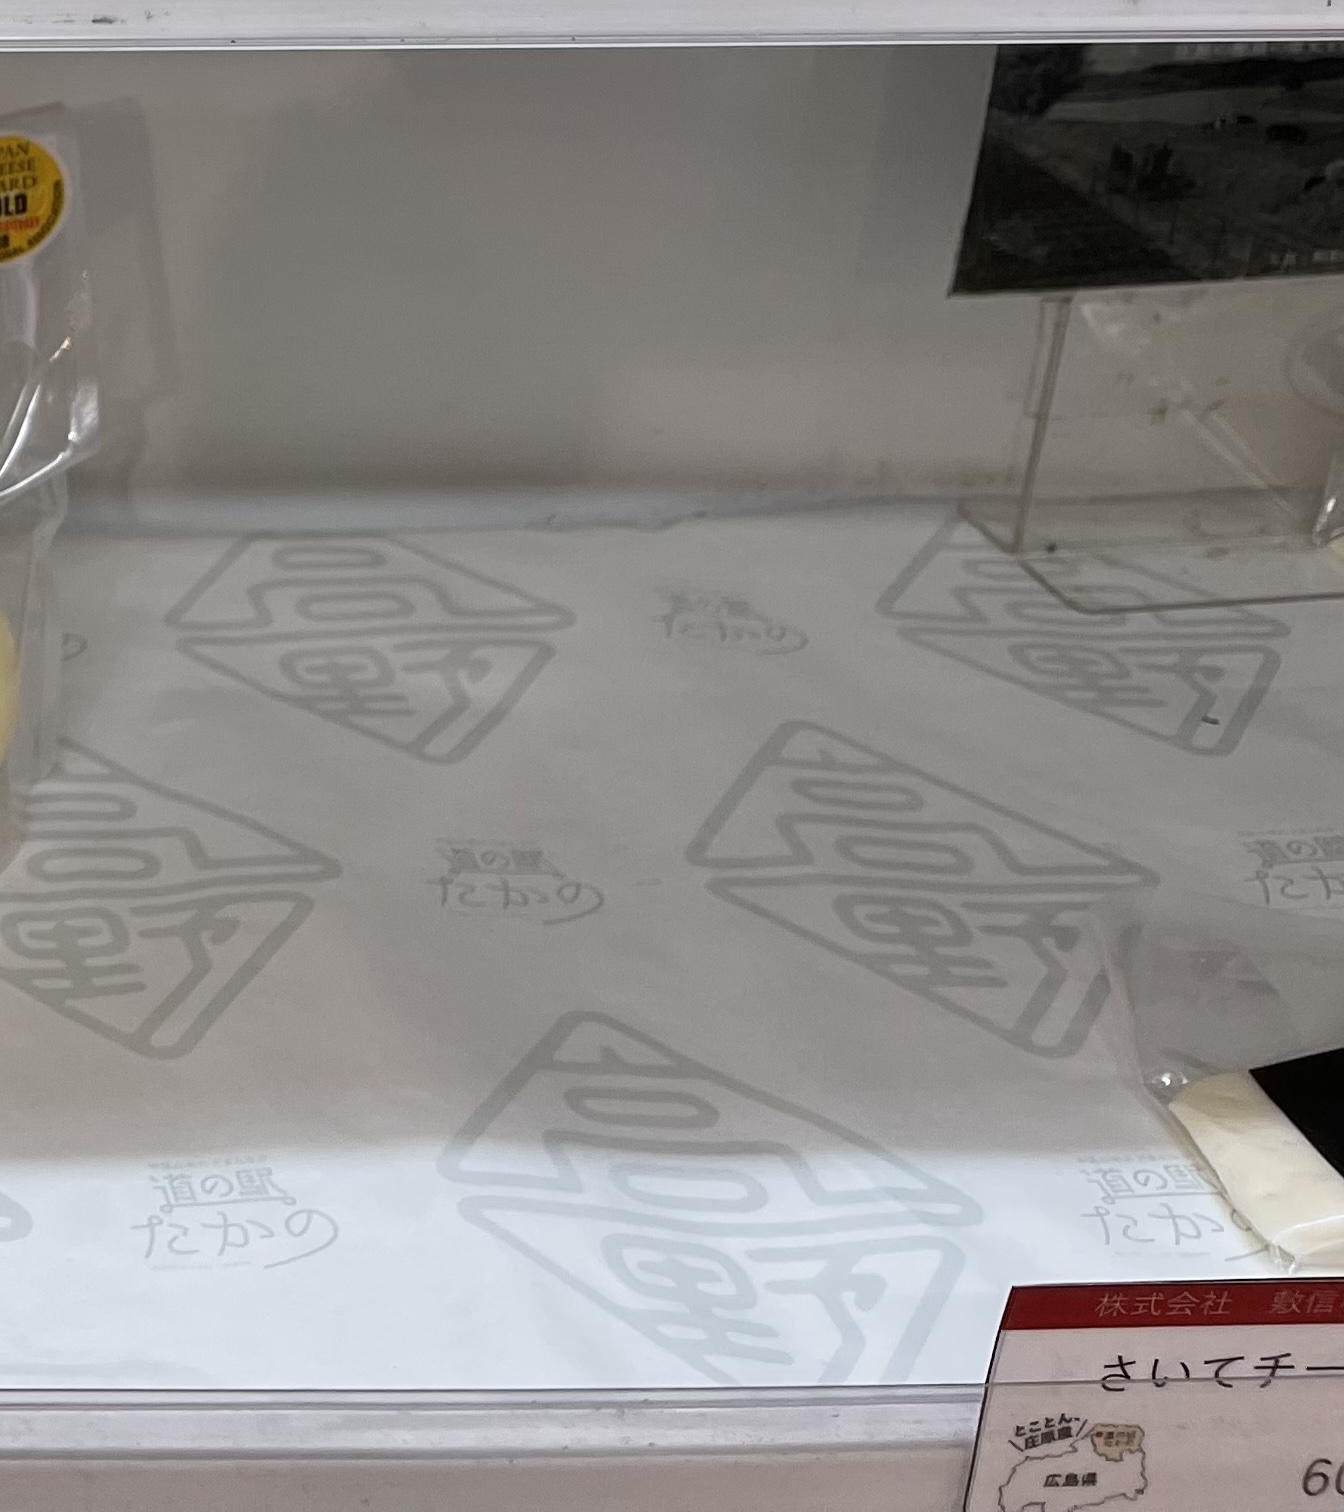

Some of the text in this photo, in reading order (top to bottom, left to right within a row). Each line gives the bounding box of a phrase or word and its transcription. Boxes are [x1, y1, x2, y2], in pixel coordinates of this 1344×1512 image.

[1096, 1292, 1232, 1317] 株式会社
[1043, 1472, 1097, 1488] 広島県
